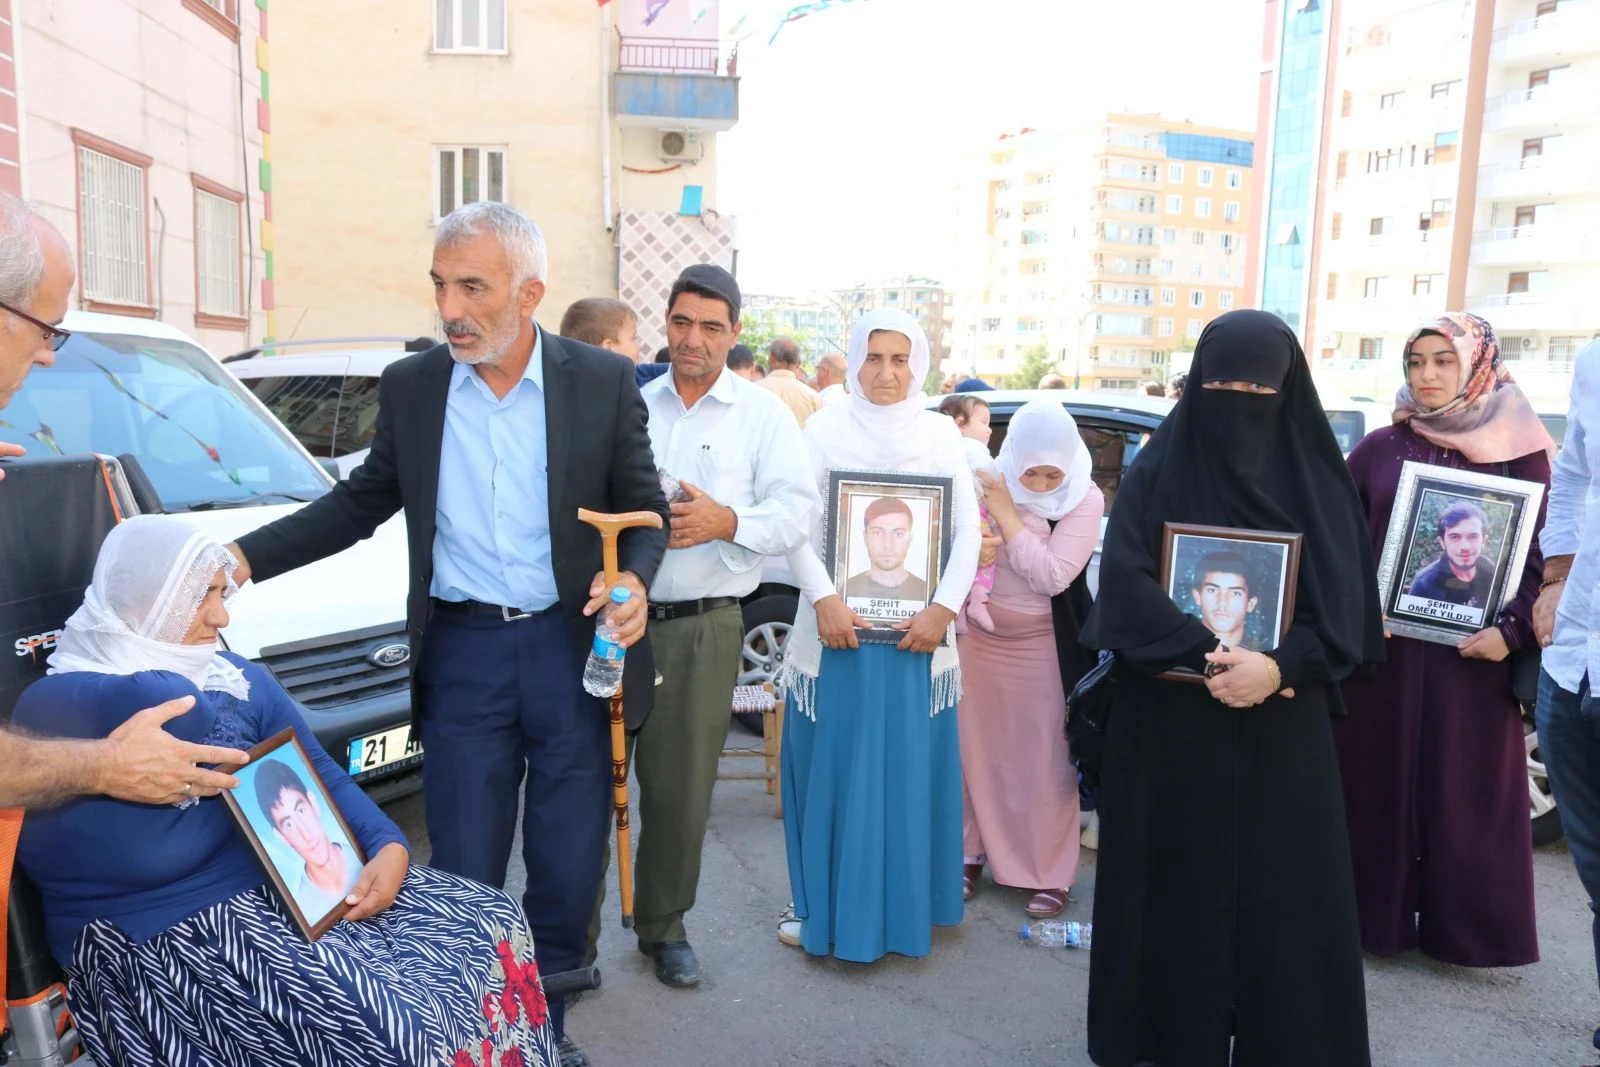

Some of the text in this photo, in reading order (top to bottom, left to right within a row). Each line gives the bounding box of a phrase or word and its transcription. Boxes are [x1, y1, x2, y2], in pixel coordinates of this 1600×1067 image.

[1440, 610, 1474, 623] YILDIZ
[364, 735, 387, 768] 21
[351, 758, 361, 768] TR
